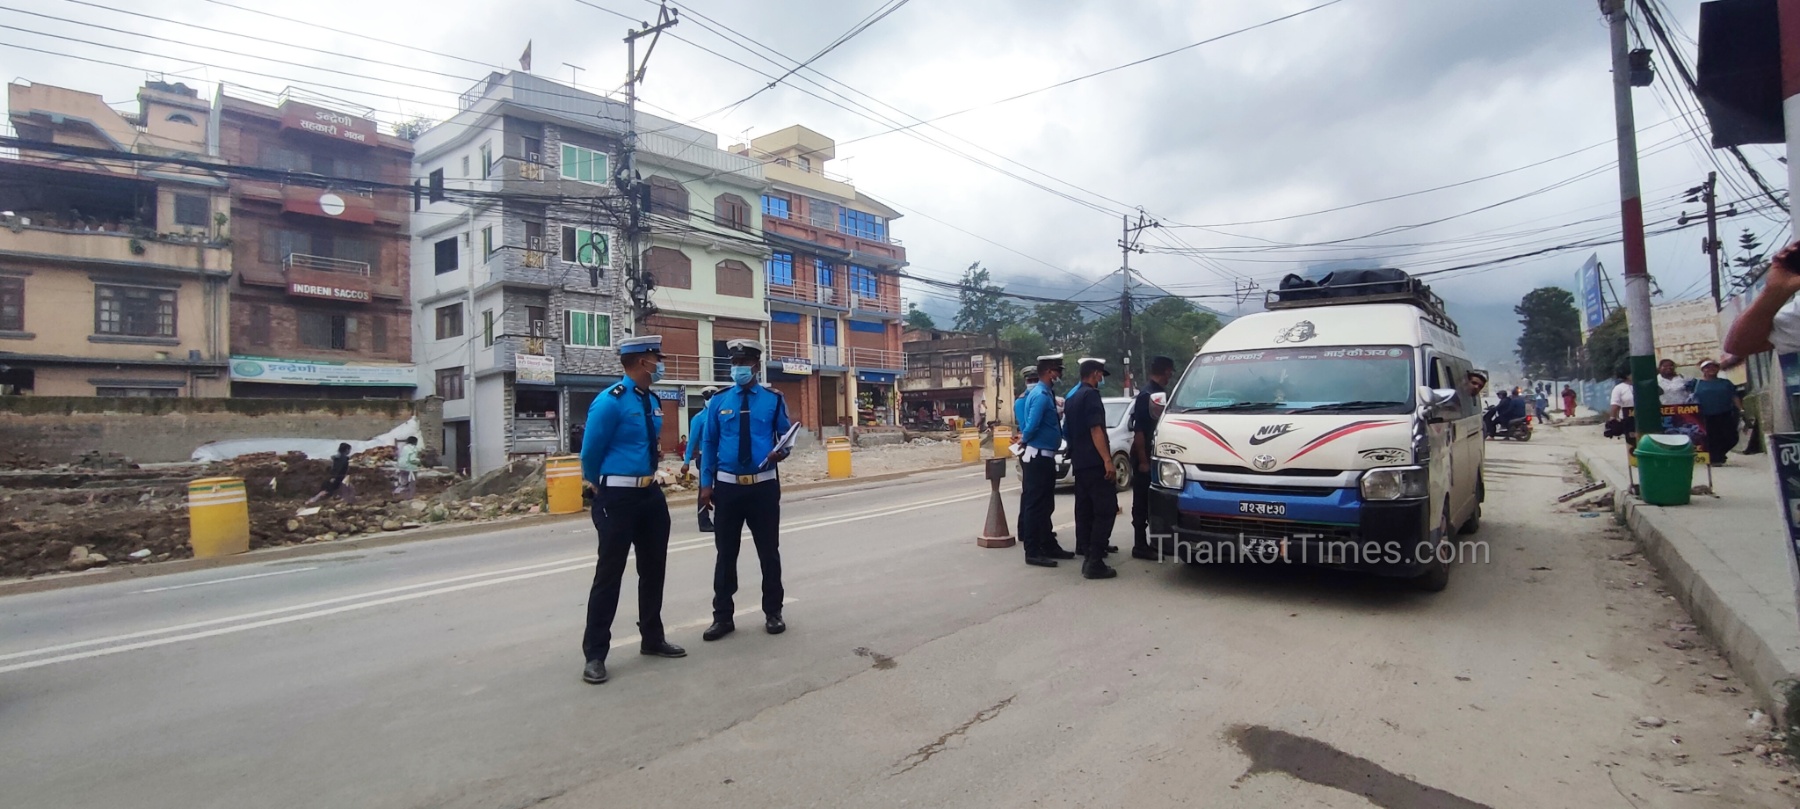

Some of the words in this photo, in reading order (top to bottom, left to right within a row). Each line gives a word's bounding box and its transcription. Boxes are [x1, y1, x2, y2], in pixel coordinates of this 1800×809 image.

[300, 119, 337, 136] सहकारी
[344, 130, 365, 142] भवन
[293, 283, 332, 296] INDRENI
[334, 287, 370, 300] SACCOS
[1677, 405, 1699, 415] RAM
[1256, 422, 1294, 437] NIKE
